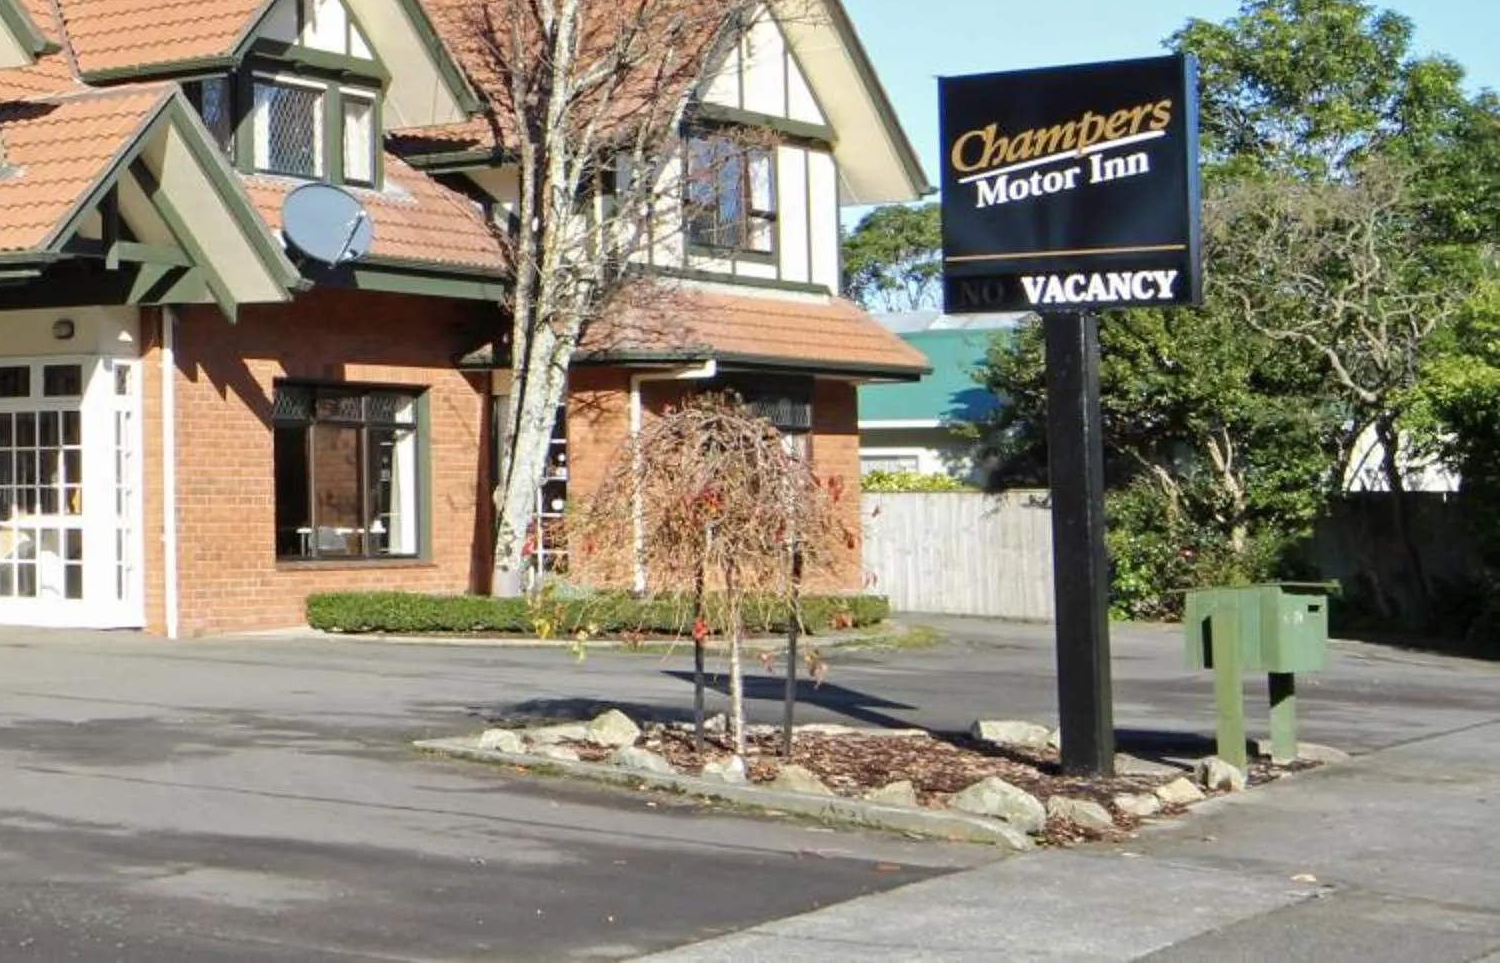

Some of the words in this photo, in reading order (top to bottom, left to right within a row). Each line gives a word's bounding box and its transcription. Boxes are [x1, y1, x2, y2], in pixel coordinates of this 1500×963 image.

[951, 98, 1173, 173] Champers
[975, 166, 1081, 209] Motor
[1088, 150, 1150, 185] Inn
[1019, 269, 1178, 305] VACANCY
